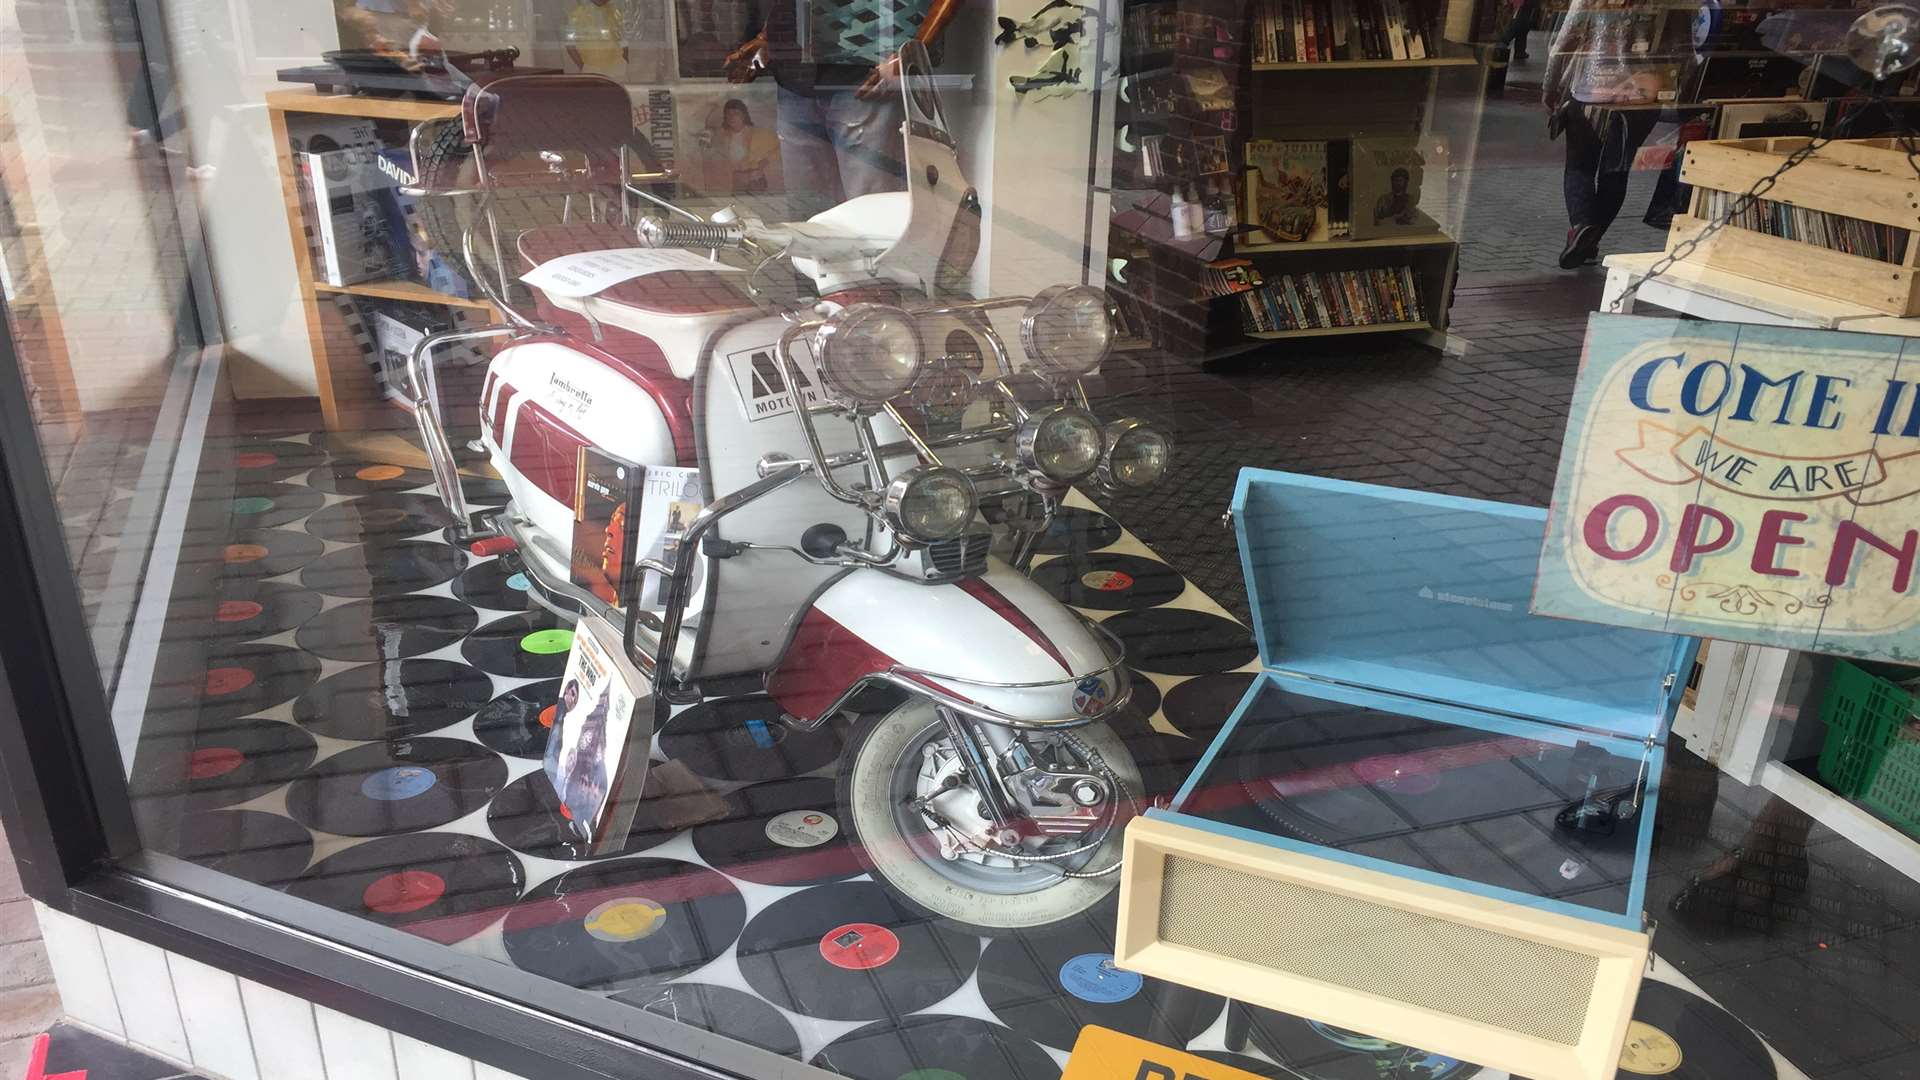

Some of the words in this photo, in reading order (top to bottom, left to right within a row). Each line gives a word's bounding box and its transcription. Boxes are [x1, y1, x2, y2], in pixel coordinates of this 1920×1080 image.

[377, 154, 412, 185] DAVID
[1628, 352, 1851, 430] COME
[1696, 440, 1758, 487] WE
[1769, 461, 1864, 492] ARE
[1583, 494, 1919, 593] OPEN
